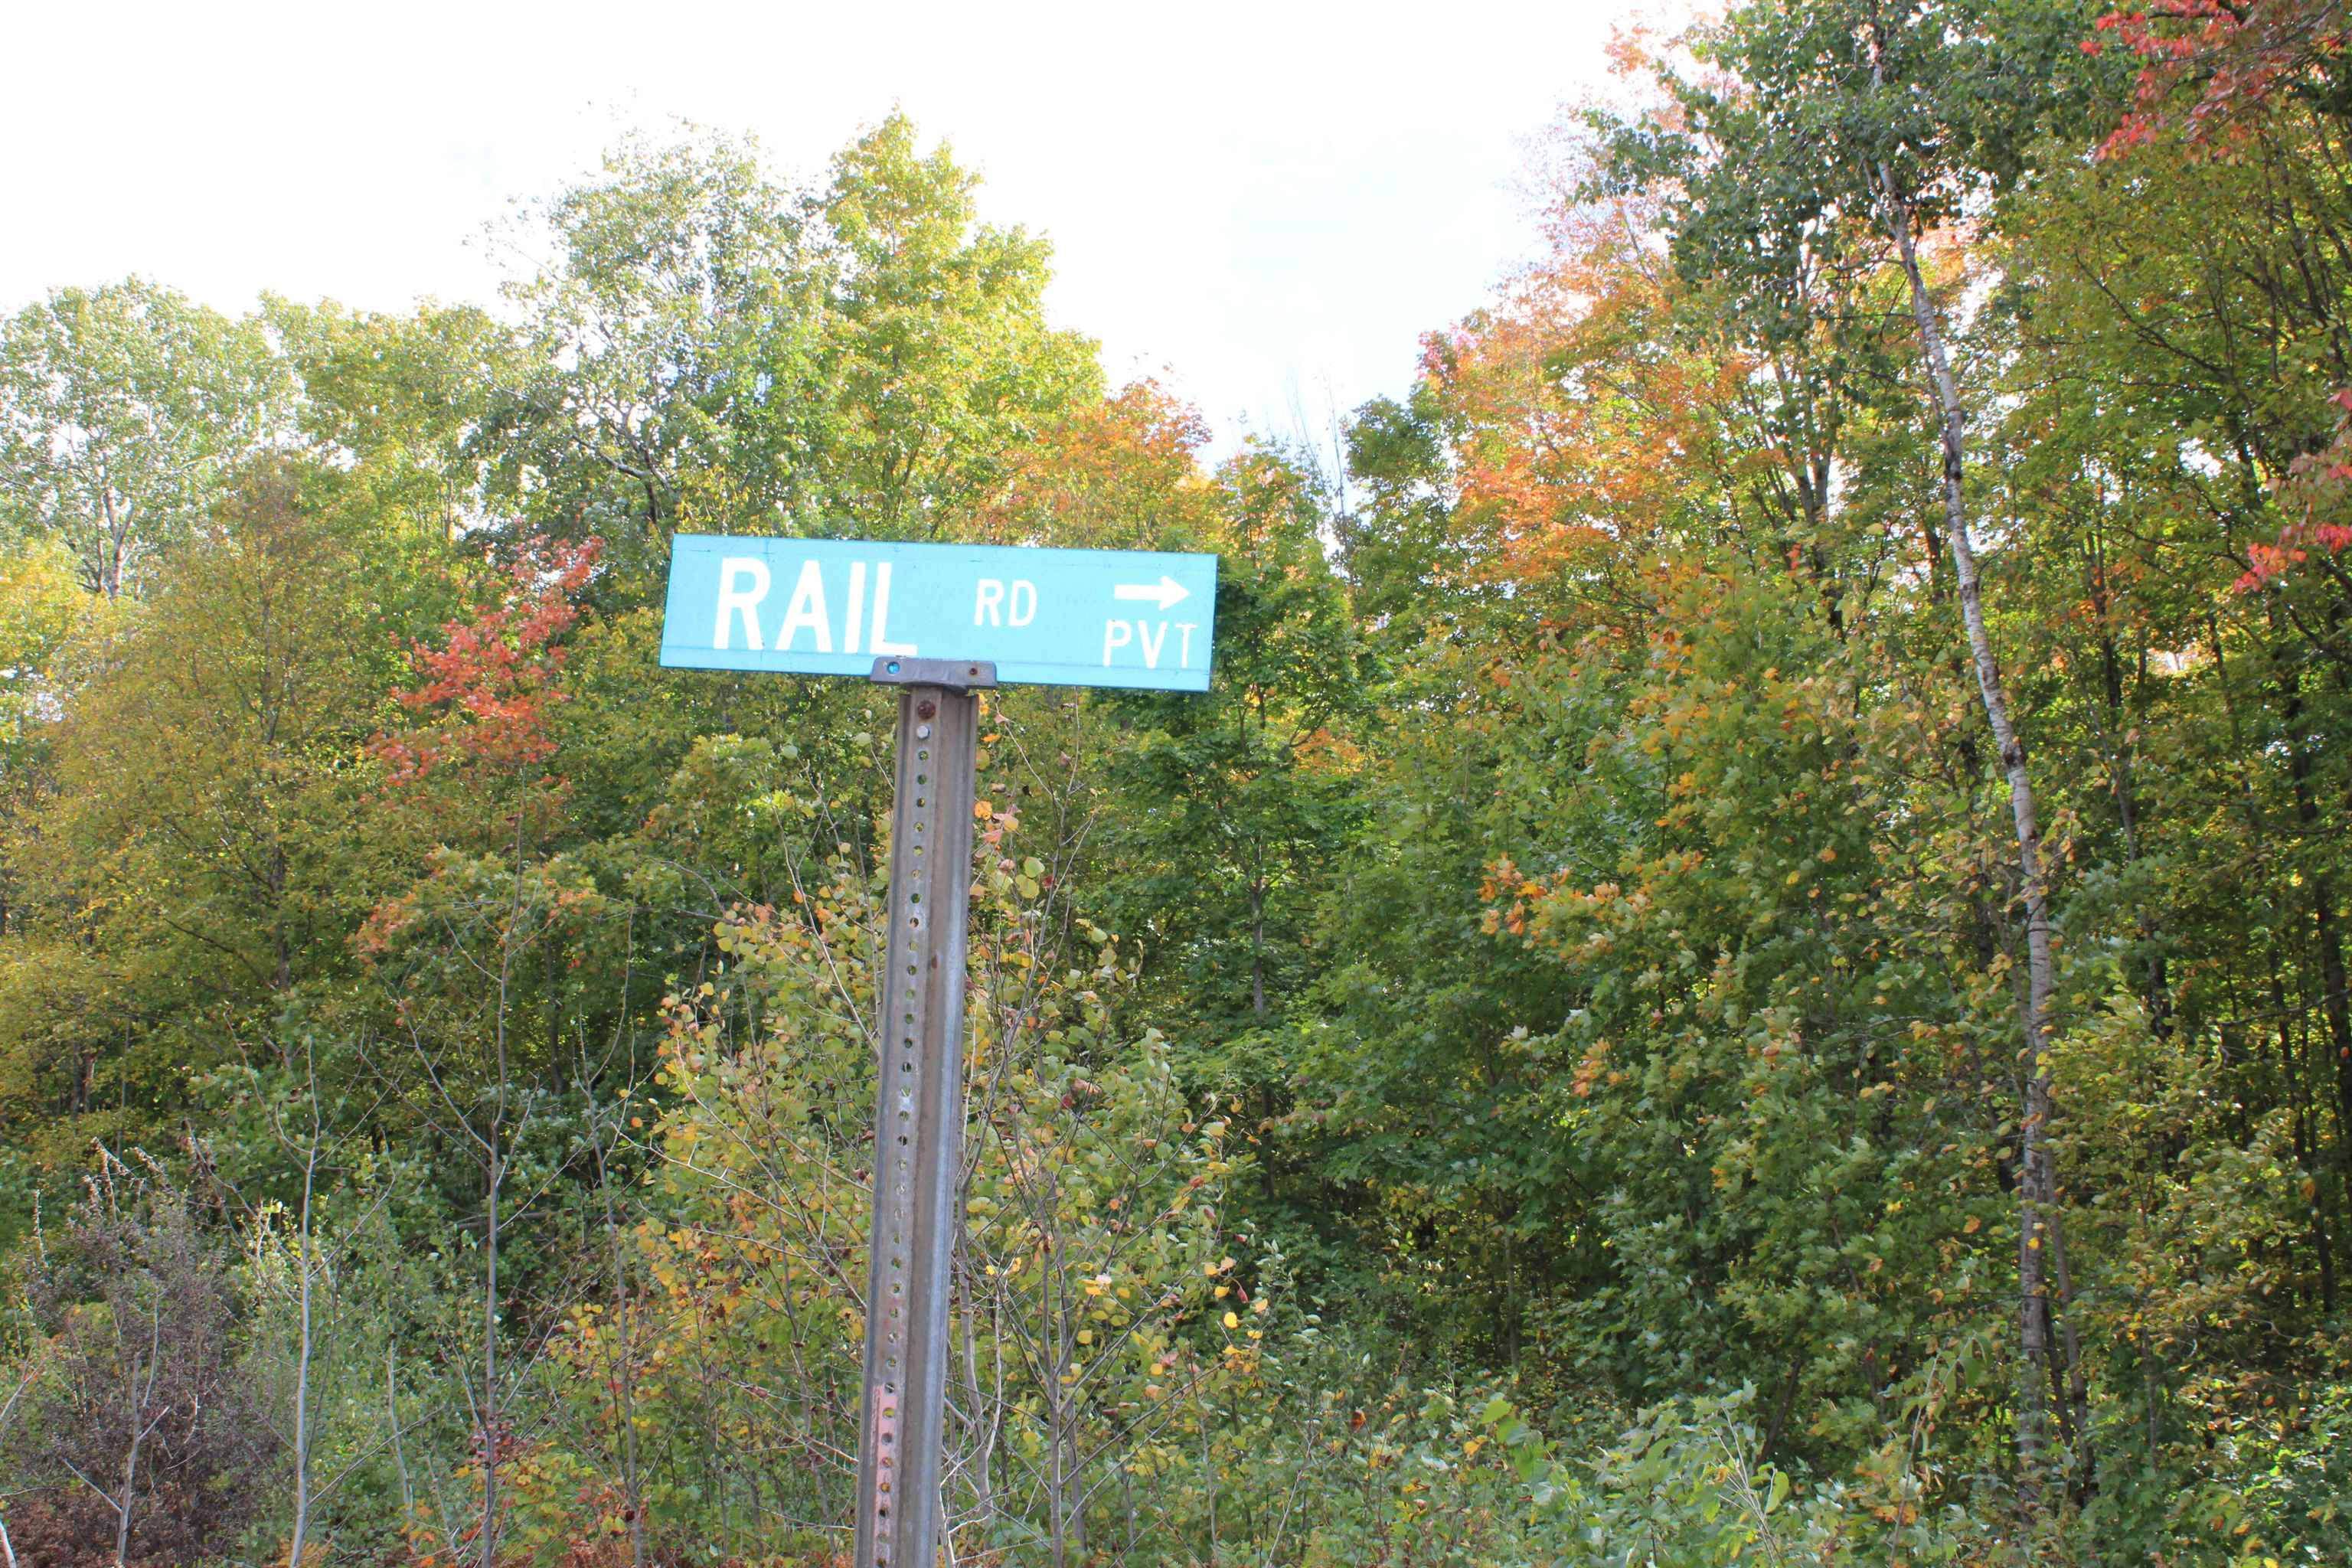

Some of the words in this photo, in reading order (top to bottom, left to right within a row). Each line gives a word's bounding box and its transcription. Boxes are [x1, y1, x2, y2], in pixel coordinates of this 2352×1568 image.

[713, 557, 919, 657] RAIL
[974, 578, 1038, 627] RD
[1102, 619, 1198, 669] PVT
